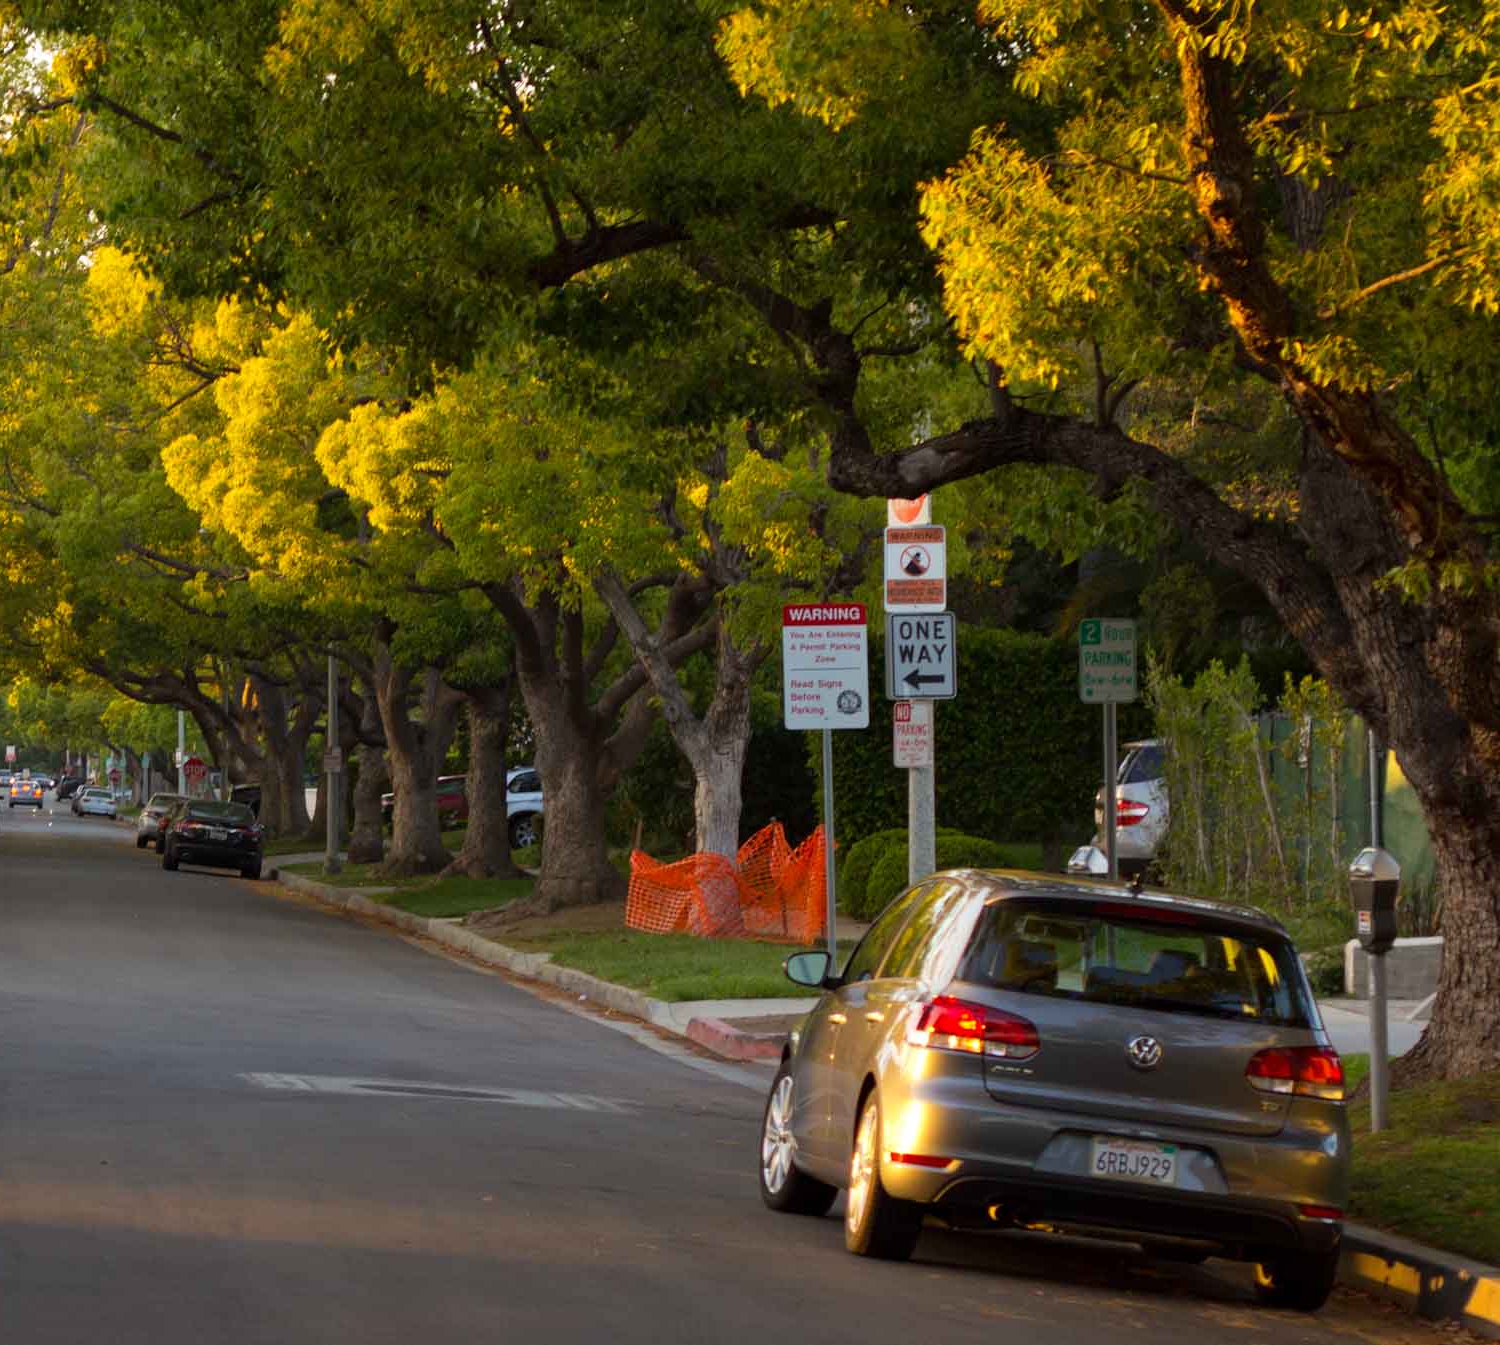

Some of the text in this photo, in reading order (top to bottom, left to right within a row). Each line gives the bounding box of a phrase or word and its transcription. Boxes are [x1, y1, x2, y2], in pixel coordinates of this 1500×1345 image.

[789, 607, 861, 621] WARNING
[826, 631, 861, 639] Entering
[900, 621, 946, 640] ONE
[1086, 624, 1096, 640] 2
[830, 643, 861, 651] Parking
[899, 645, 947, 663] WAY
[1084, 651, 1132, 666] PARKING
[790, 680, 842, 689] Read Signs
[790, 693, 820, 701] Before
[791, 706, 825, 716] Parking
[897, 705, 909, 720] NO
[896, 724, 928, 736] PARKING
[1096, 1151, 1172, 1178] 6RBJ929
